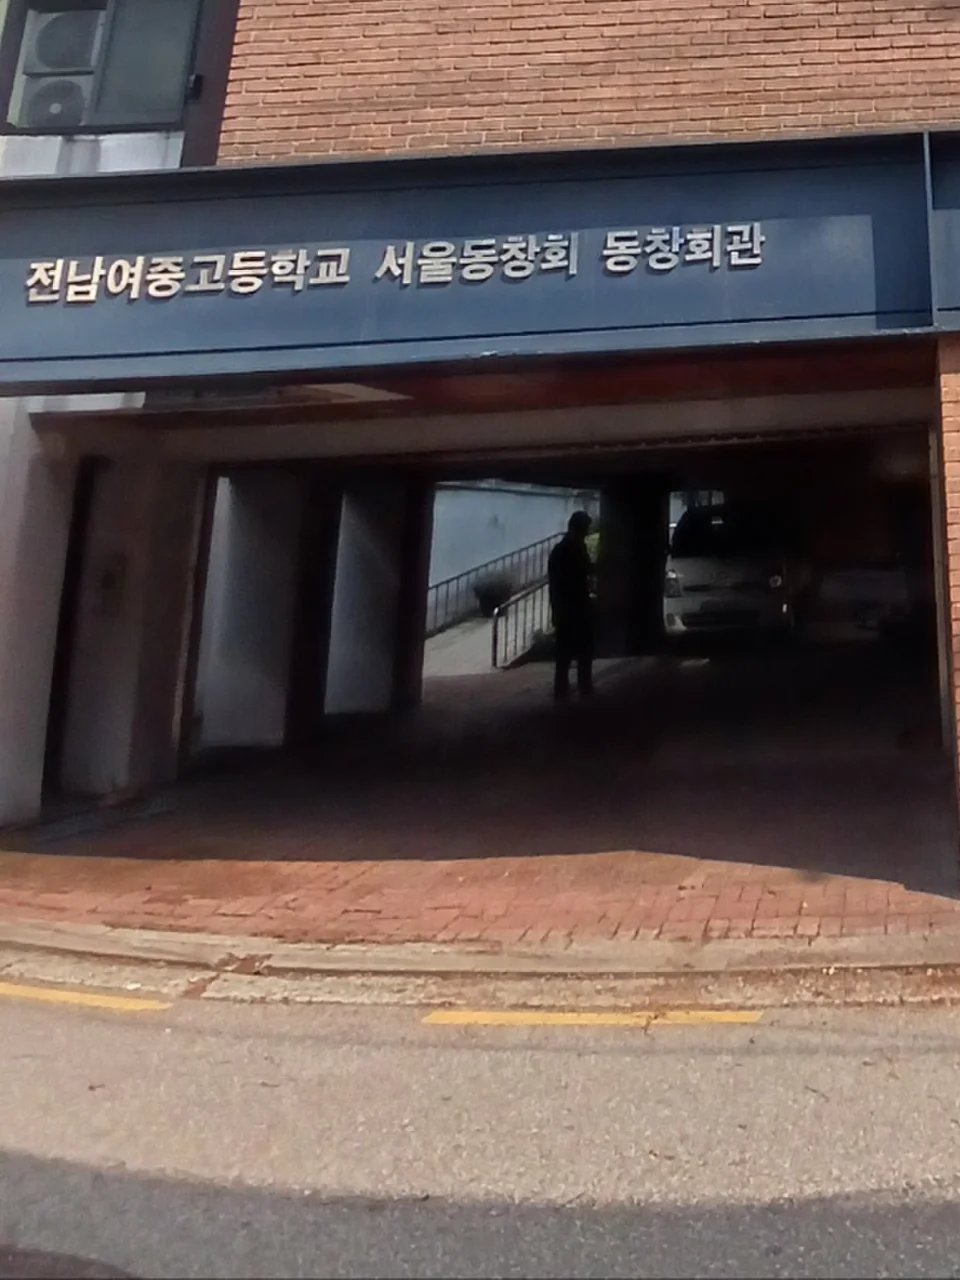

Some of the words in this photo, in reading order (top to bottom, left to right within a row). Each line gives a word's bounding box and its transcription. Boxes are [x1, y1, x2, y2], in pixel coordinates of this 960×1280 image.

[26, 247, 350, 303] 전남여중고등학교
[375, 231, 579, 284] 서울동창회
[602, 222, 766, 272] 동창회관
